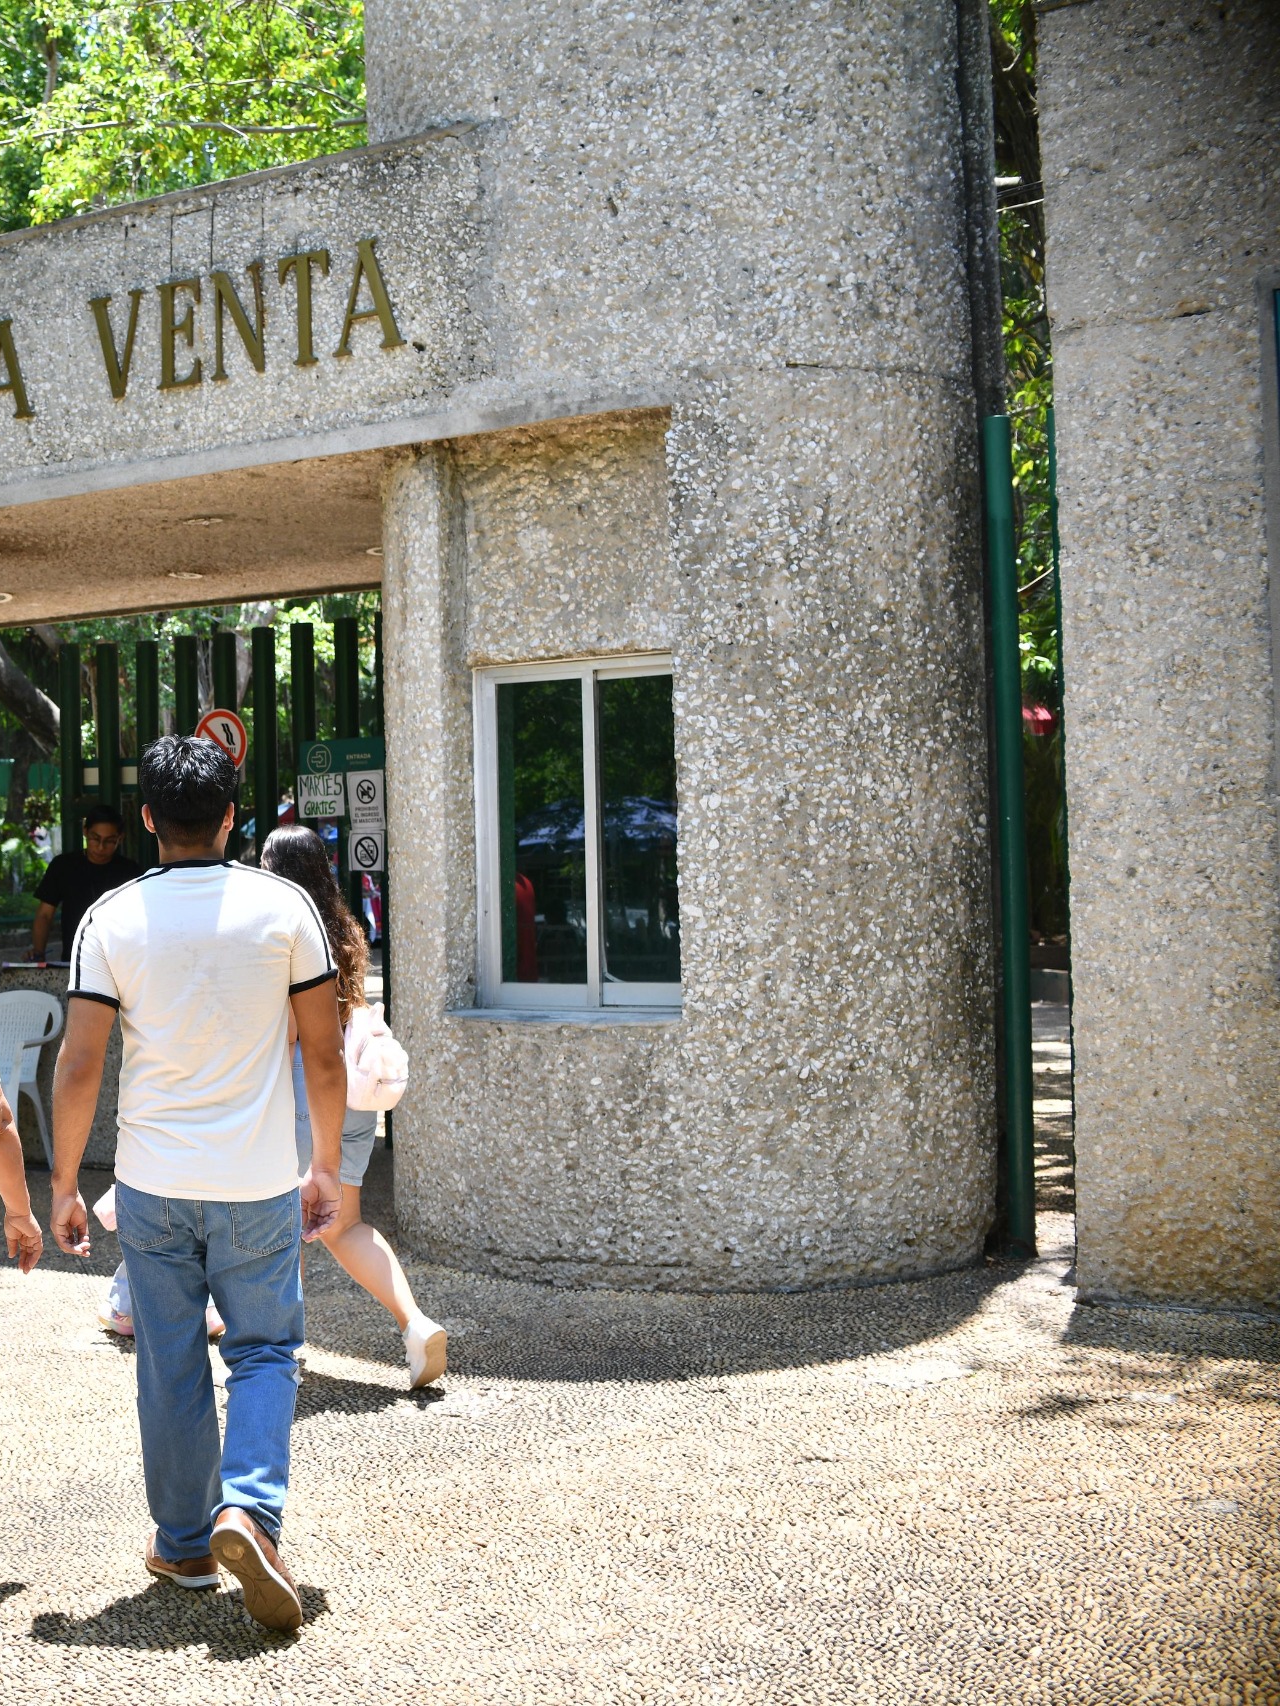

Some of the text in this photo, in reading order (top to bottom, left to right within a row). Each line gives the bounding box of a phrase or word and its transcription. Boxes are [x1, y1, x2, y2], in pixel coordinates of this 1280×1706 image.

[87, 237, 407, 399] VENTA
[299, 773, 342, 797] MARTES
[304, 800, 336, 816] GRATIS
